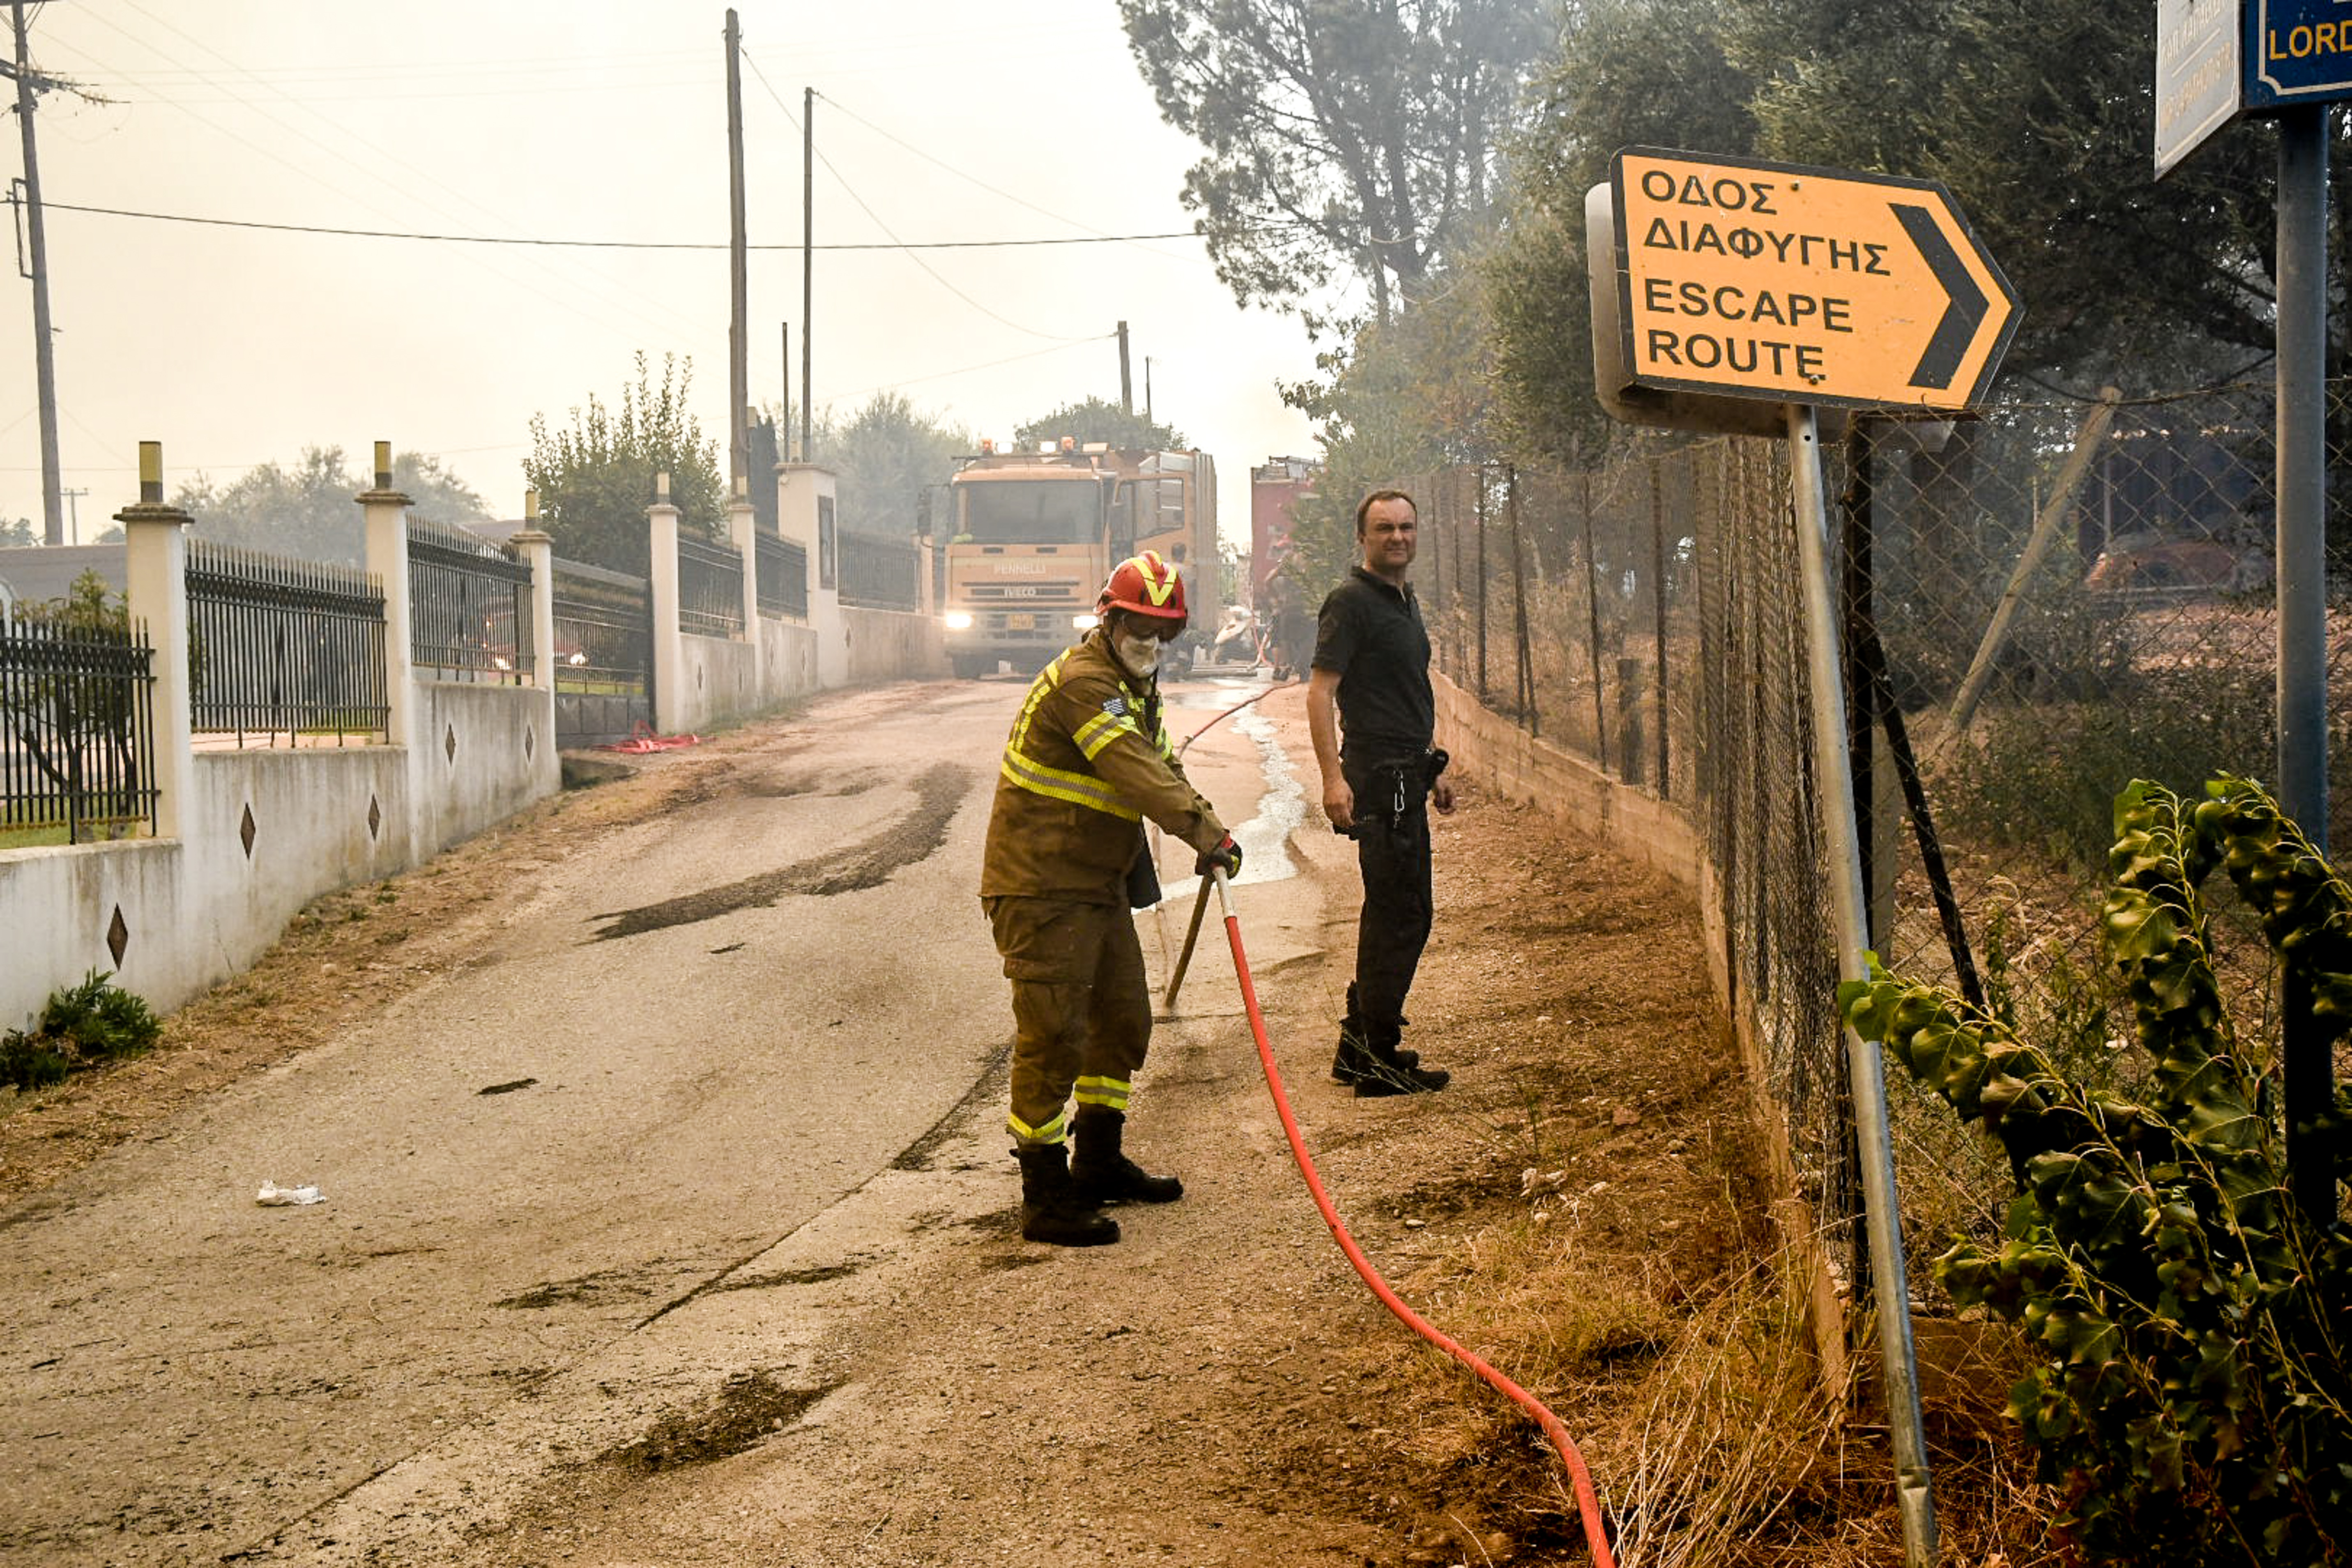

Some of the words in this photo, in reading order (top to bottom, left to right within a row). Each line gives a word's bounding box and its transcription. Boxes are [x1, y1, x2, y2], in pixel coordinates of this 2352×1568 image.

[1642, 170, 1777, 215] ΟΔΟΣ
[1644, 218, 1891, 276] ΔΙΑΦΥΓΗΣ
[1645, 279, 1853, 333] ESCAPE
[1648, 329, 1826, 381] ROUTE
[1004, 587, 1036, 597] IVECO
